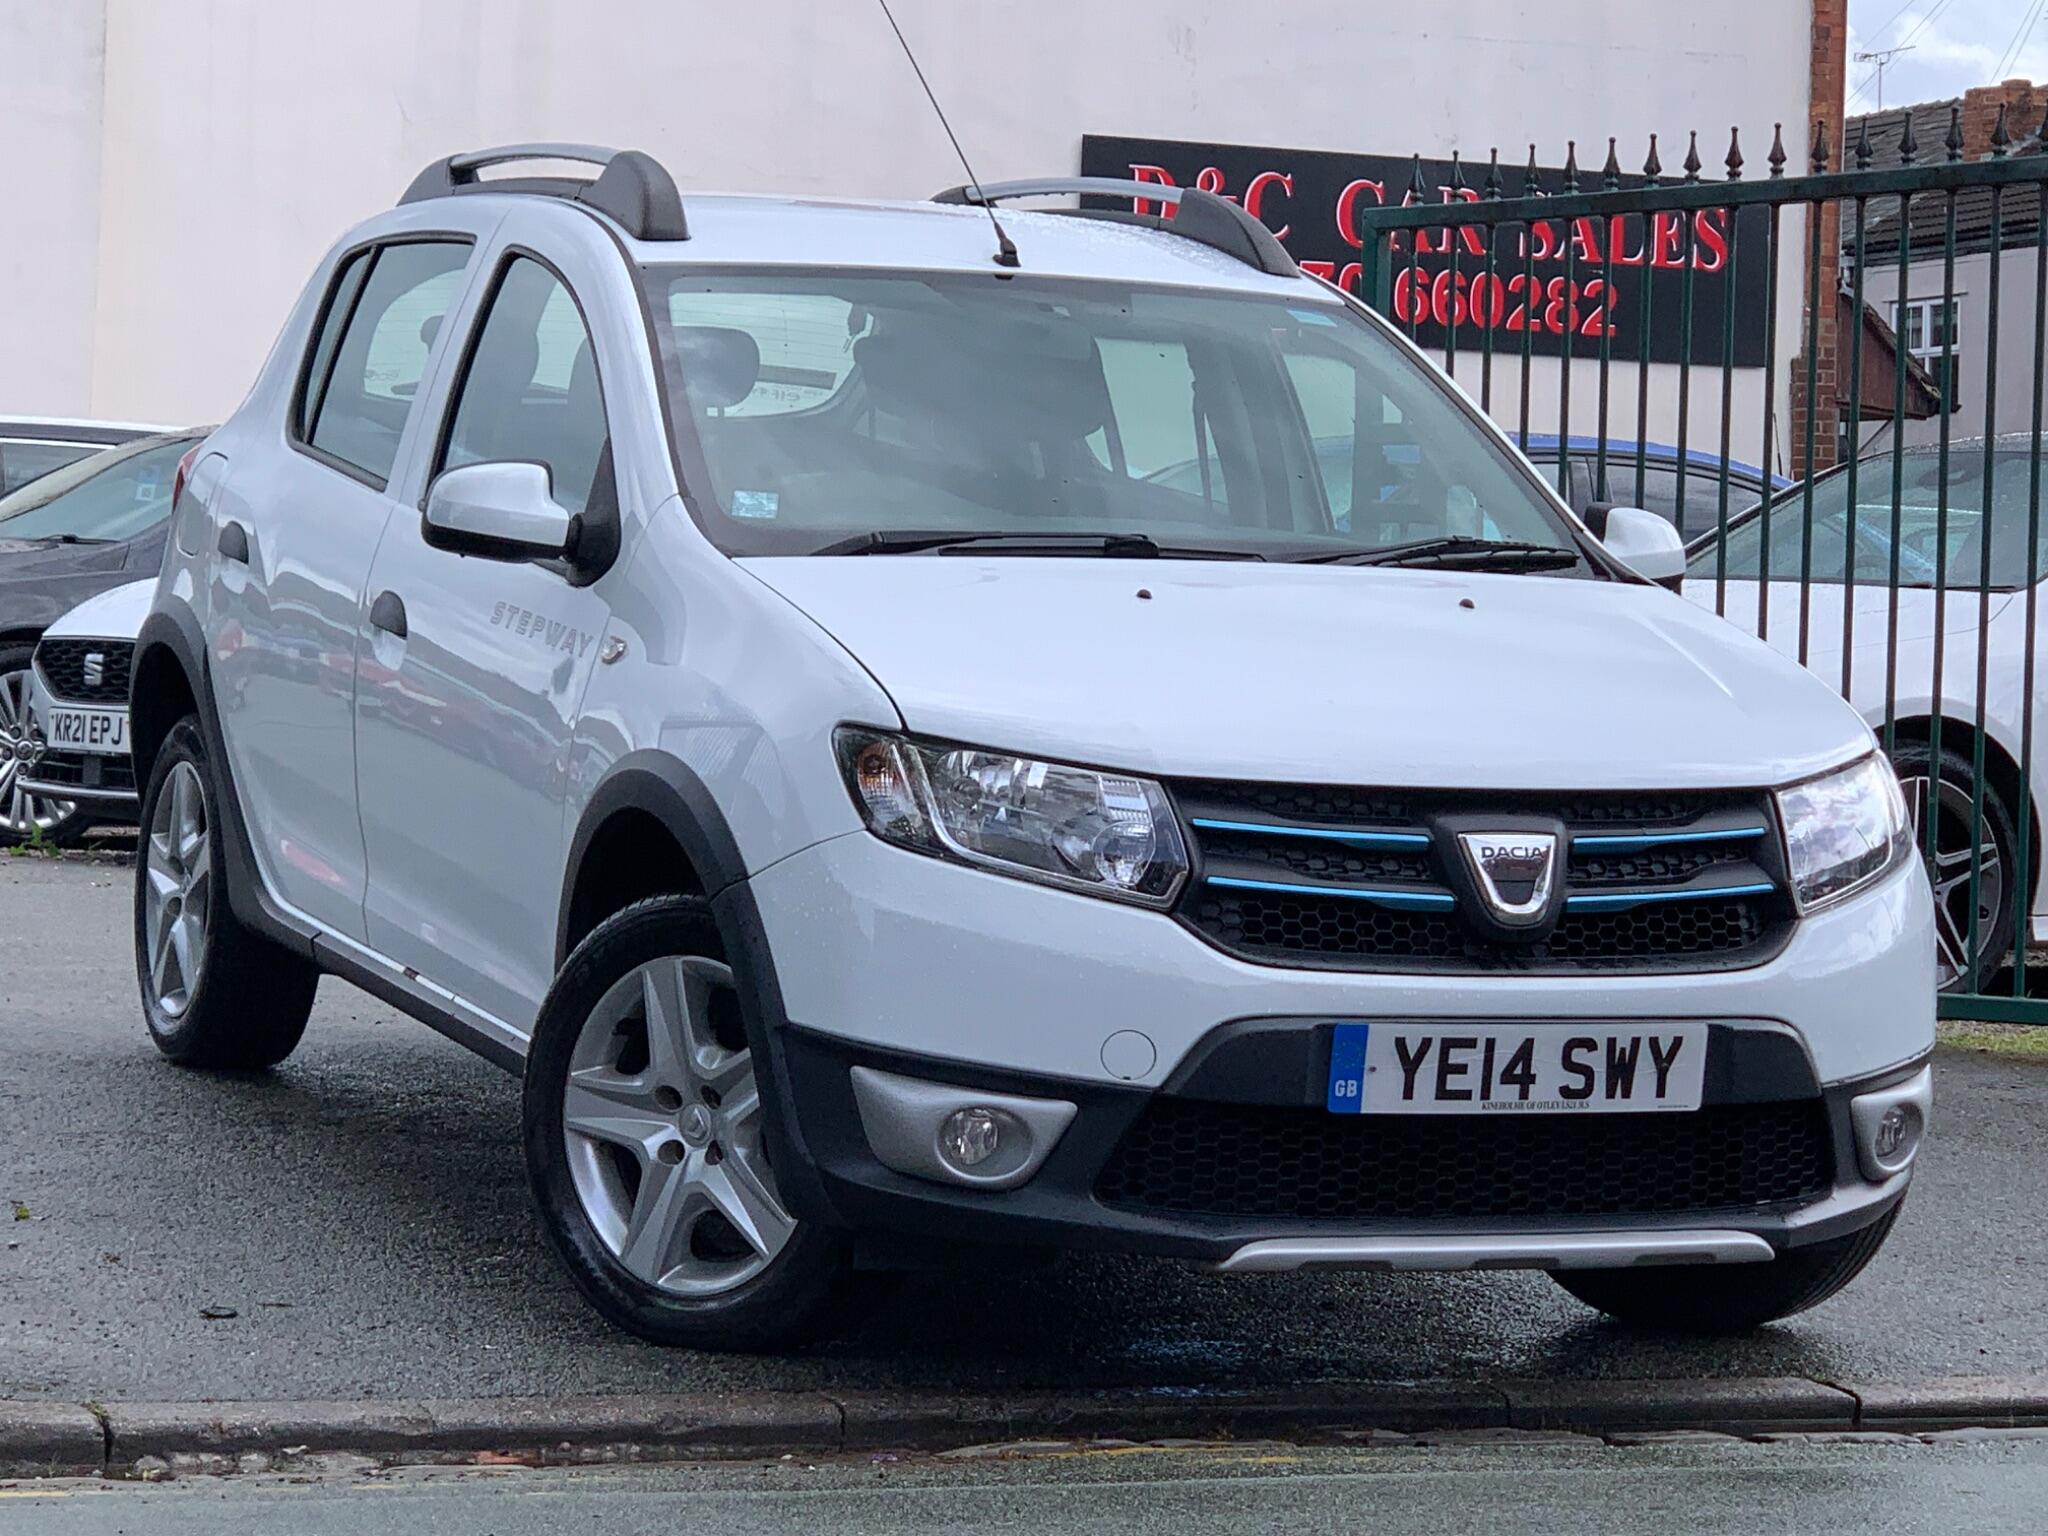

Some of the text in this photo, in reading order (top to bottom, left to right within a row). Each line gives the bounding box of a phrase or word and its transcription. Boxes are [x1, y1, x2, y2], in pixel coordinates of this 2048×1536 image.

[1394, 266, 1617, 336] 660282
[490, 601, 595, 658] STEPWAY
[54, 713, 123, 745] KR21 EPJ
[1481, 846, 1545, 858] DACIA
[1335, 1080, 1357, 1097] GB
[1394, 1036, 1684, 1101] YE14 SWY
